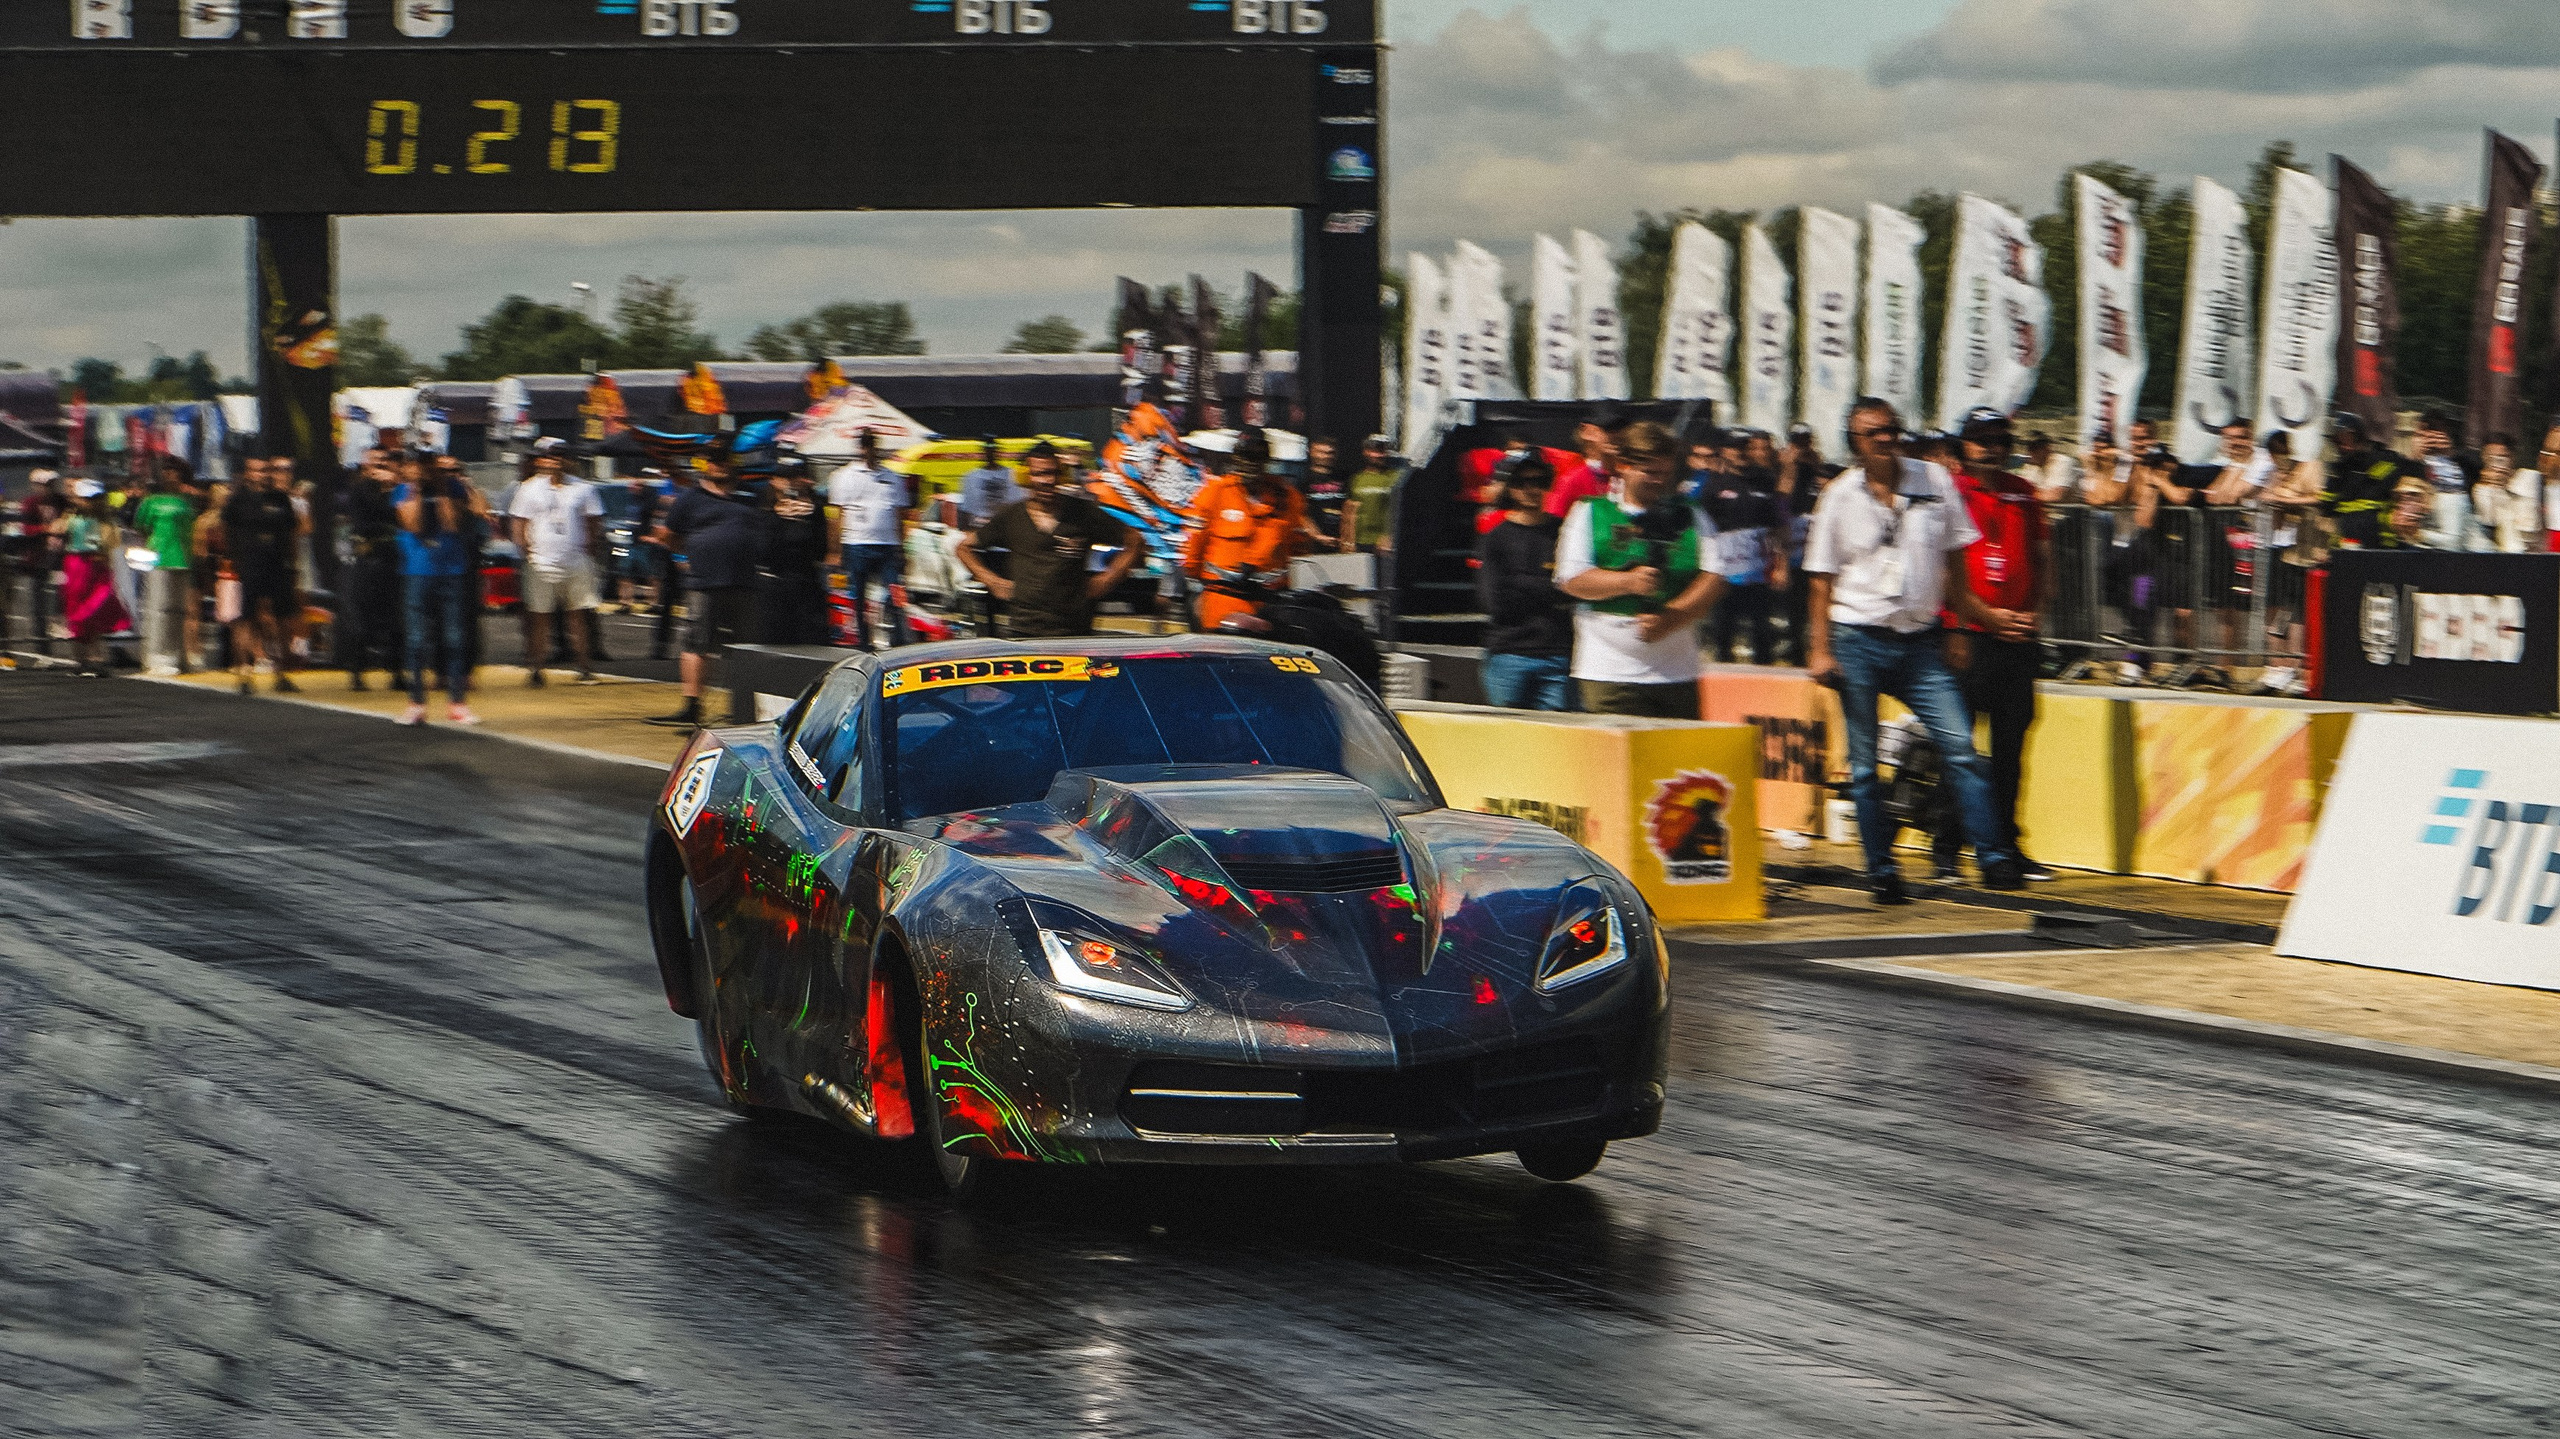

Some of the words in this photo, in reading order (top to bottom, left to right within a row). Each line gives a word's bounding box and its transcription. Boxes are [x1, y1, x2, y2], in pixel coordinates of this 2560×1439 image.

[639, 0, 741, 36] ВТБ
[954, 0, 1053, 34] ВТБ
[1232, 0, 1329, 34] ВТБ
[364, 99, 621, 175] 0.213
[917, 659, 1065, 683] RDRC
[1269, 655, 1321, 675] 99
